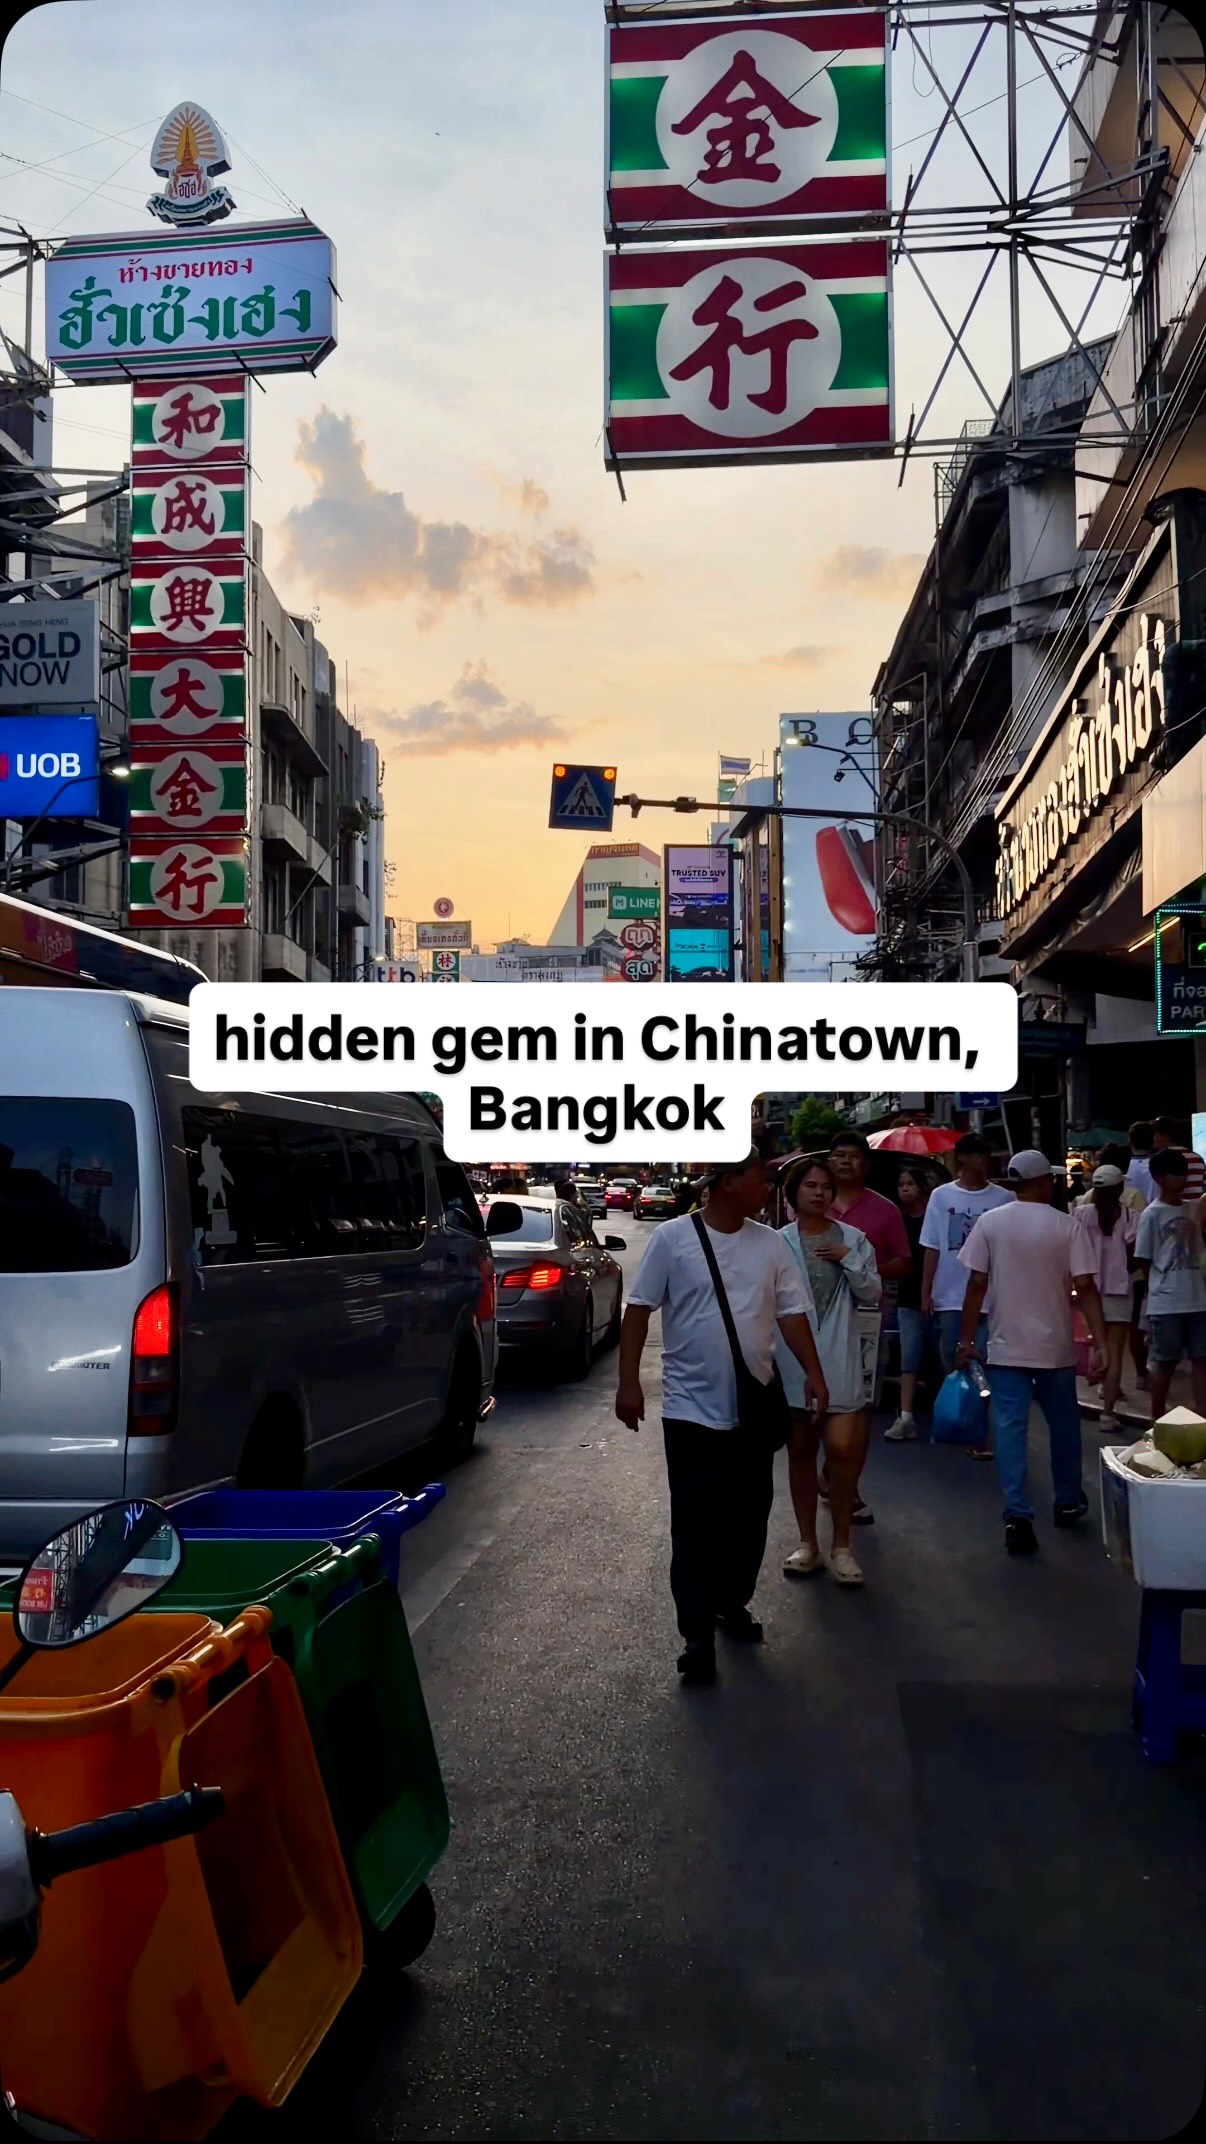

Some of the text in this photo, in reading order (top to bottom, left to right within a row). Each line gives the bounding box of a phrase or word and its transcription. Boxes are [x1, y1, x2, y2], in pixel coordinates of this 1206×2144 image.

[669, 49, 822, 415] 金行
[118, 257, 253, 284] ห้างขายทอง
[58, 275, 312, 350] ฮั่วเซ่งเฮง
[17, 752, 81, 778] UOB
[671, 869, 726, 877] TRUSTED SUV
[377, 966, 416, 982] ttb
